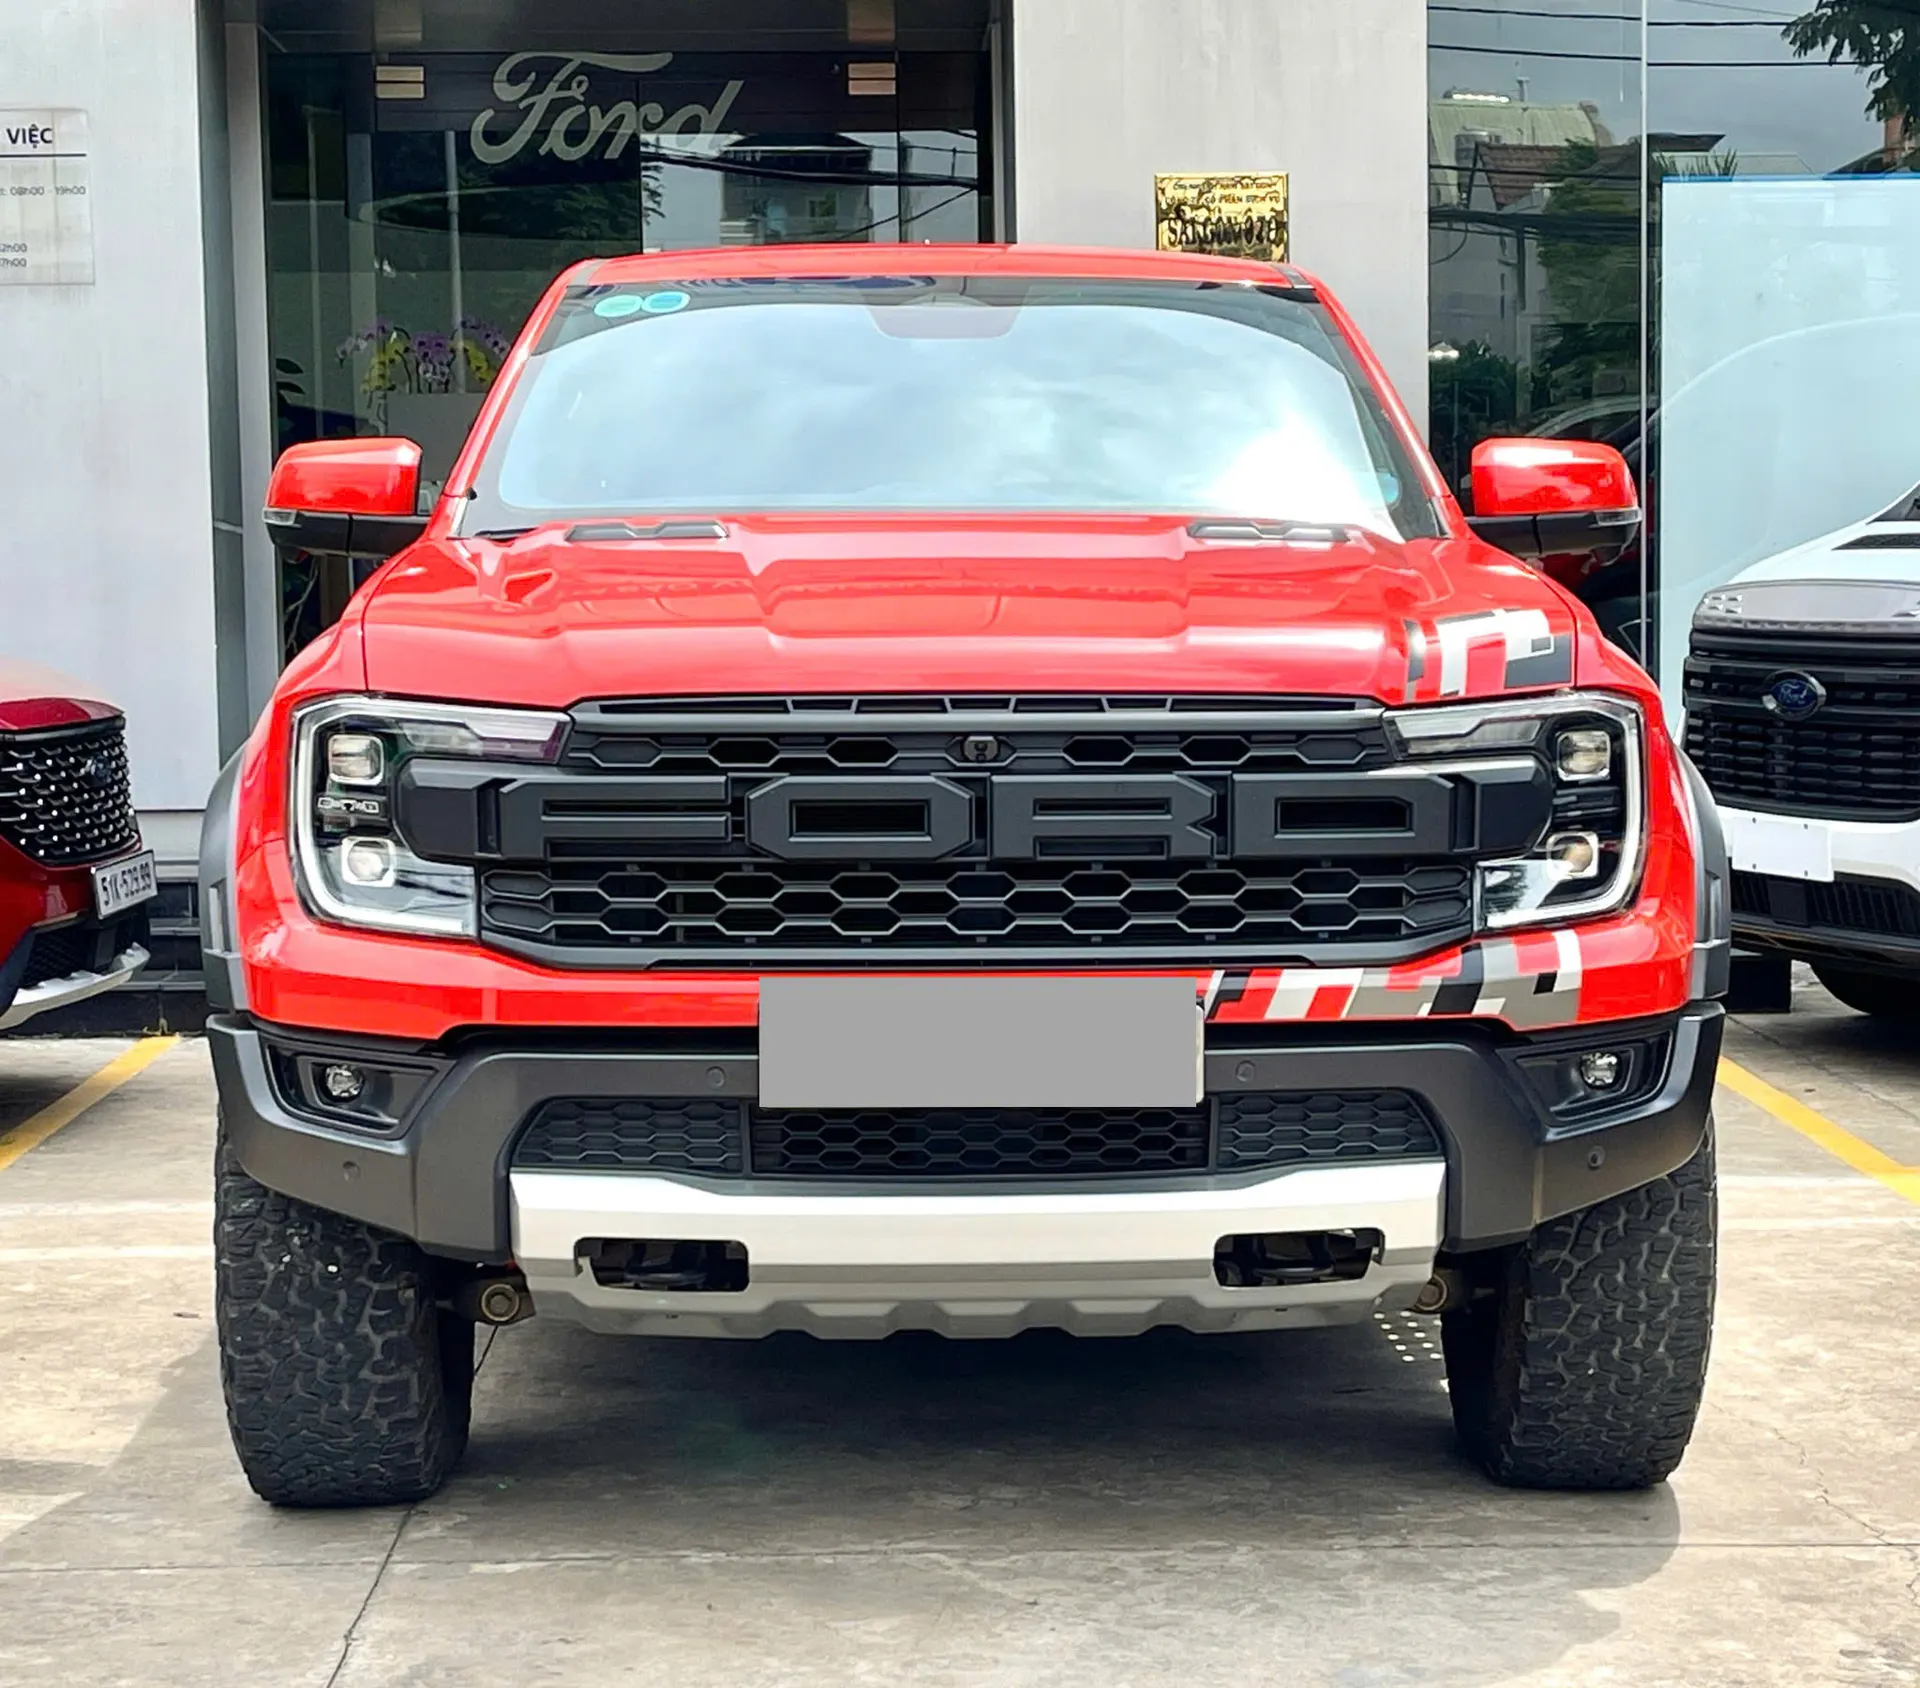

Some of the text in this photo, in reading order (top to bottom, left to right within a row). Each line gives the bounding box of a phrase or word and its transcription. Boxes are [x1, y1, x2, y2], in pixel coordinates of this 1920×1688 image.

[6, 124, 53, 148] VIỆC
[470, 51, 744, 164] Ford
[500, 775, 1455, 861] FORD
